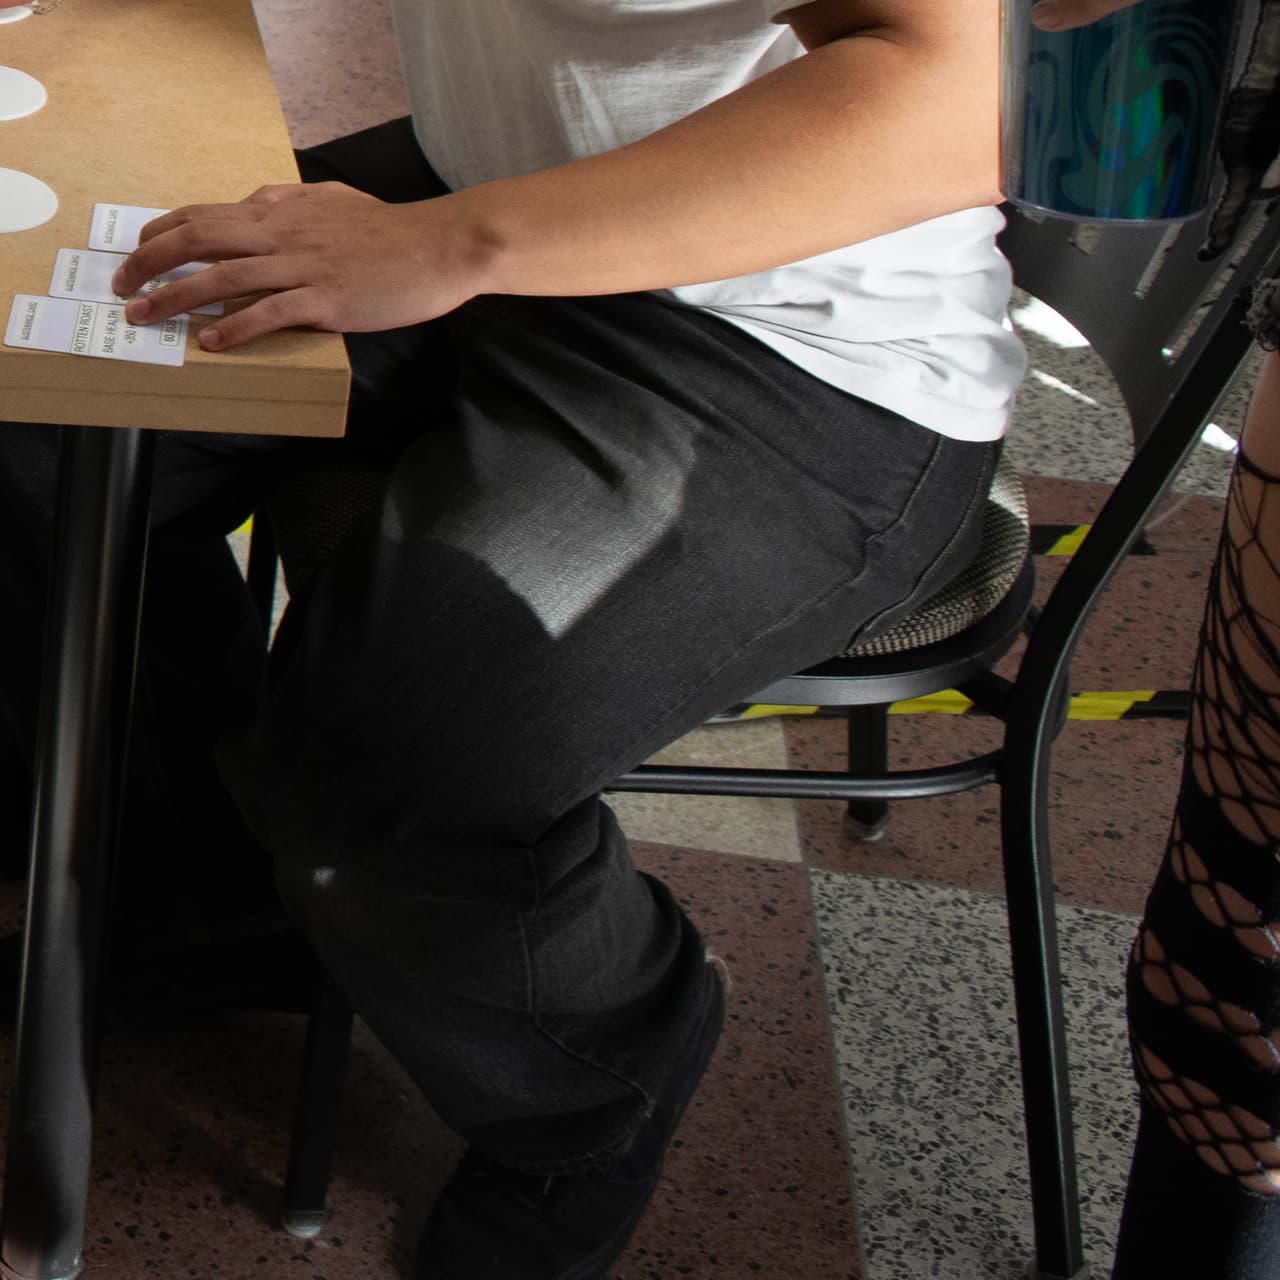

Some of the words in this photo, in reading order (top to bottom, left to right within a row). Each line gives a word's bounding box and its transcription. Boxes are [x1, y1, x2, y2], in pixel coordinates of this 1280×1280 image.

[78, 304, 93, 325] ROAST
[73, 326, 89, 352] ROTTEN
[101, 336, 116, 353] BASE
